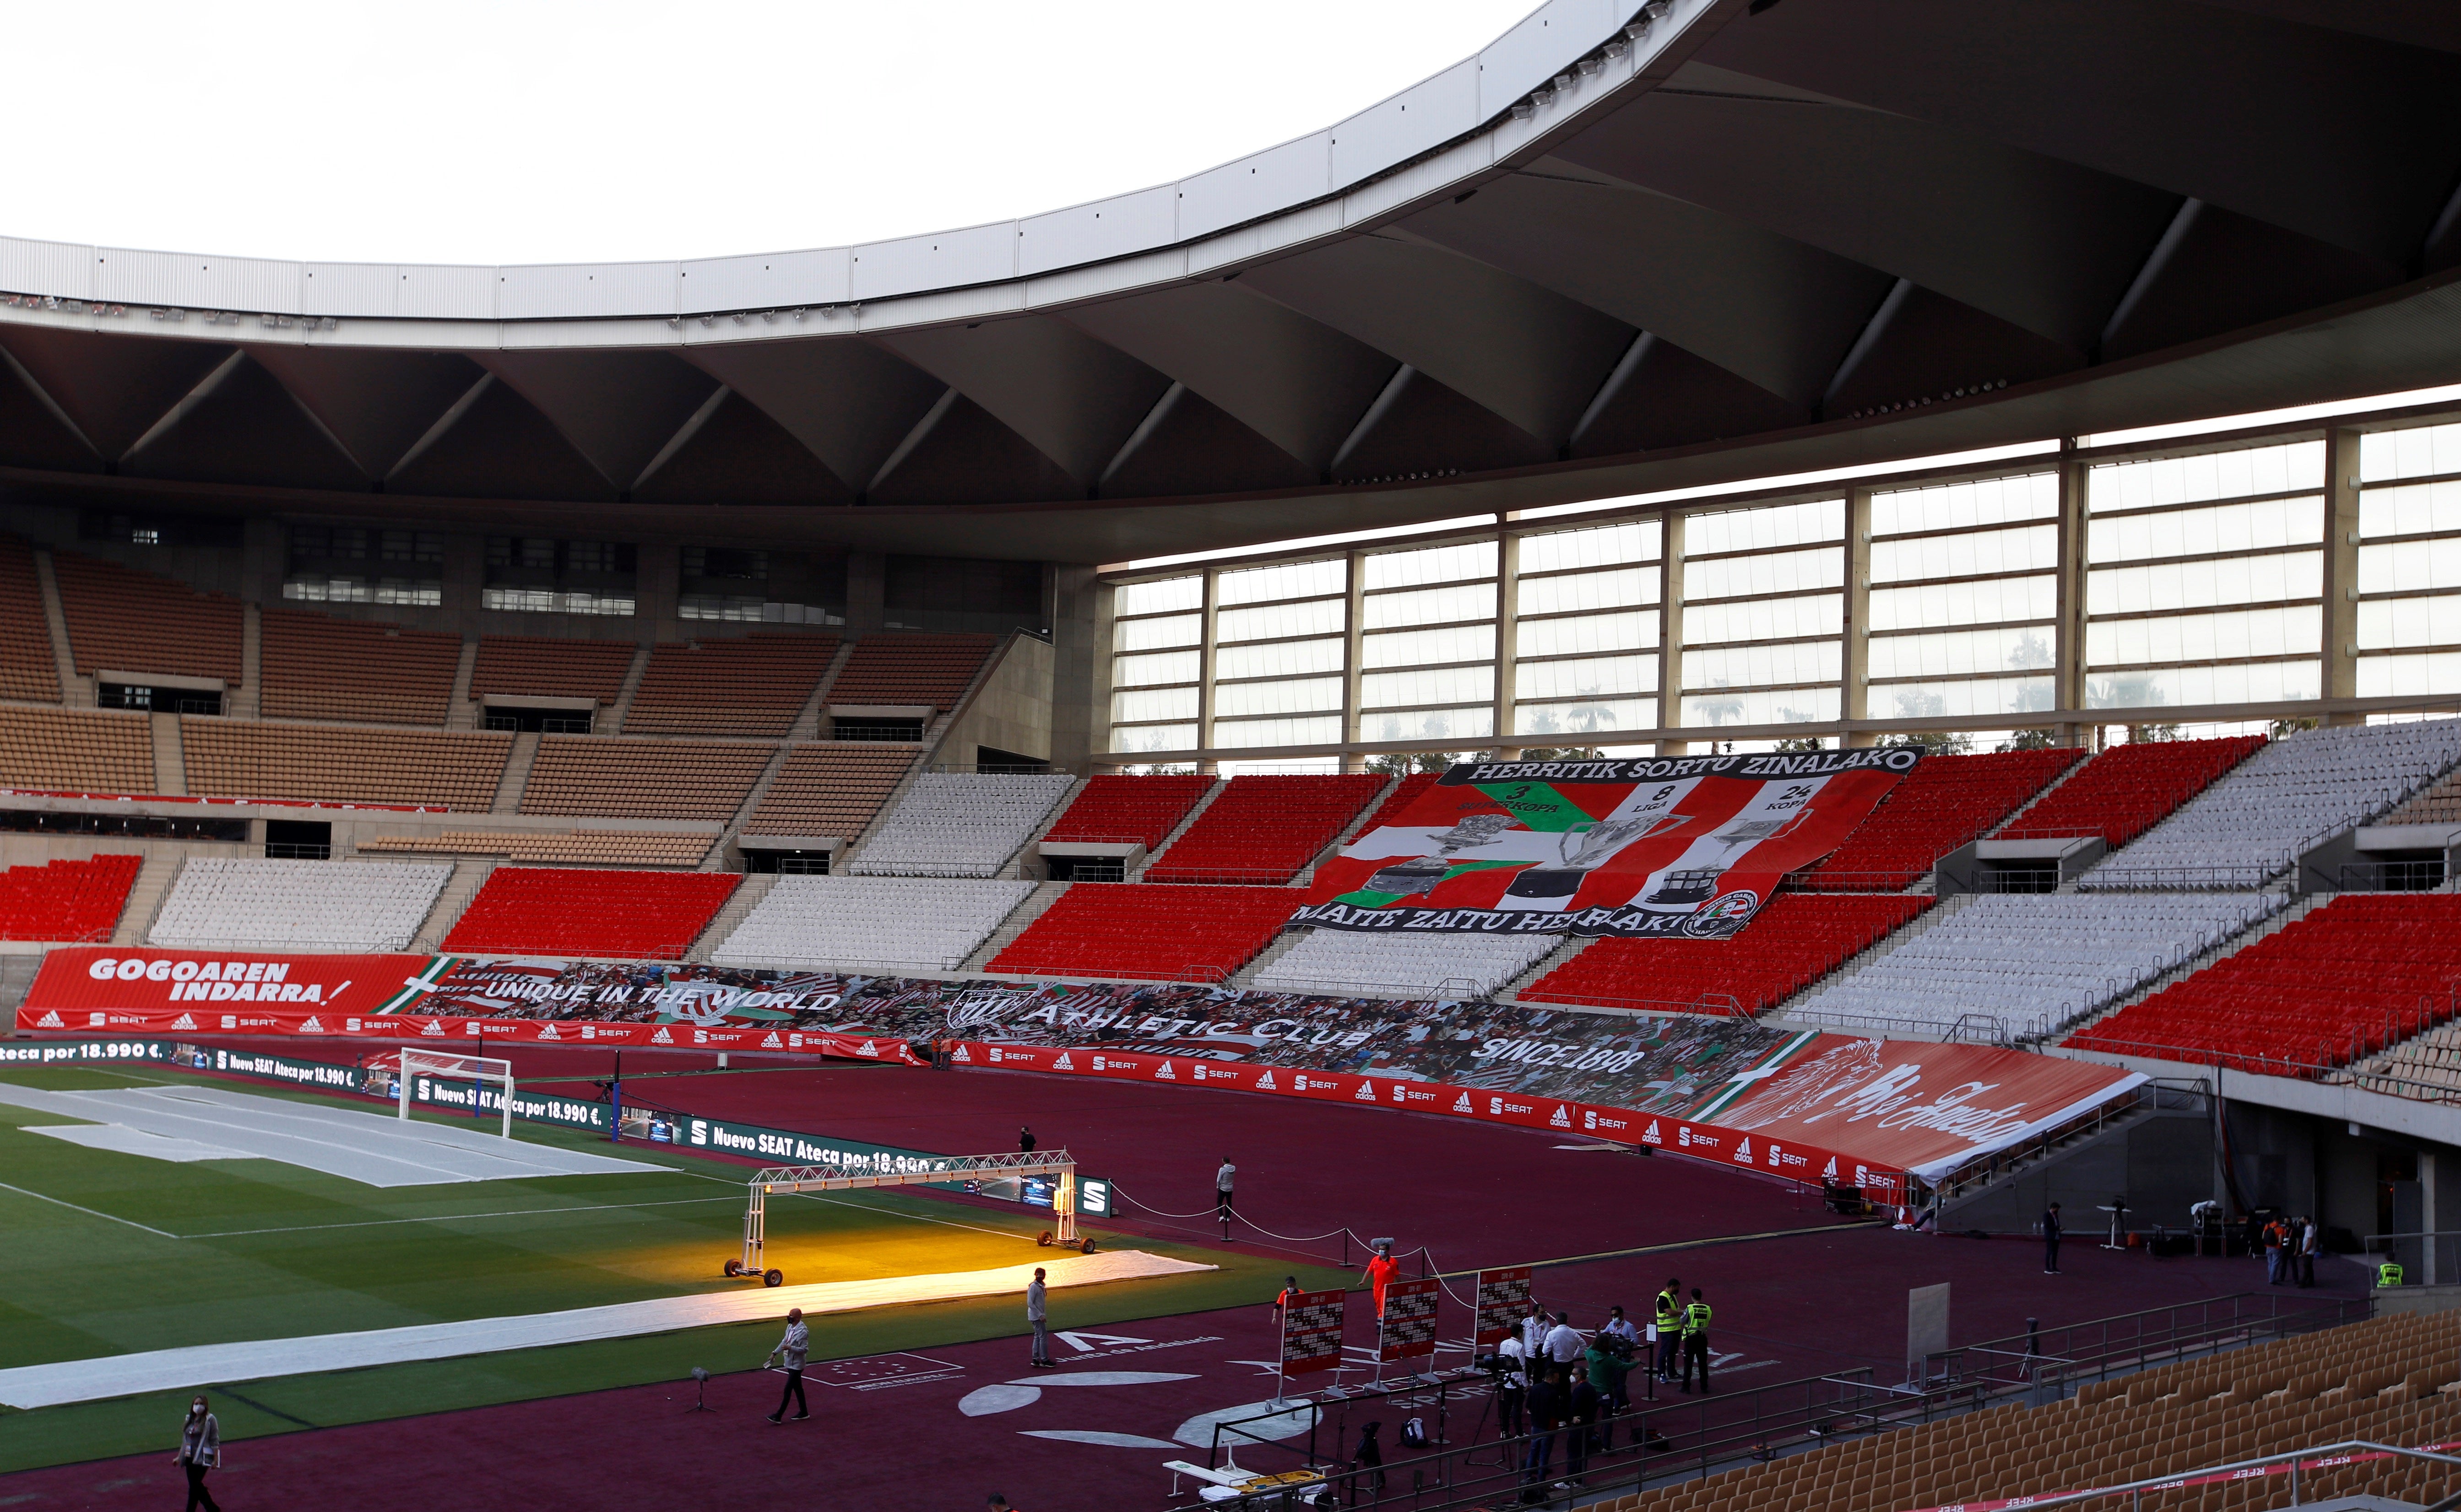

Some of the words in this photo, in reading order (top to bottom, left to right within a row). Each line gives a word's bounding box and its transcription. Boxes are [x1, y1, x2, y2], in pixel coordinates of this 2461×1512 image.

[1468, 762, 1626, 779] HERRITIK
[1627, 756, 1741, 778] SORTU
[1741, 749, 1917, 775] ZINALAKO
[1506, 785, 1531, 799] 3
[1652, 785, 1676, 801] 8
[1778, 785, 1811, 800] 24
[1457, 801, 1559, 813] SUPERKOPA
[1632, 801, 1667, 813] LIGA
[1765, 799, 1807, 810] KOPA
[1289, 904, 1405, 927] MAITE
[1402, 910, 1513, 930] ZAITU
[89, 958, 290, 983] GOGOAREN
[169, 980, 352, 1006] INDARRA!
[485, 981, 591, 1003] UNIQUE
[596, 986, 633, 1002] IN
[638, 988, 708, 1005] THE
[711, 989, 840, 1010] WORLD
[1019, 1005, 1238, 1036] ATHLETIC
[1252, 1019, 1373, 1047] CLUB
[806, 1038, 837, 1046] SEAT
[0, 1047, 39, 1060] teca
[43, 1047, 76, 1062] por
[80, 1043, 145, 1058] 18.990
[1005, 1053, 1035, 1061] SEAT
[1470, 1038, 1580, 1066] SINCE
[1561, 1048, 1645, 1074] 1898
[230, 1054, 254, 1071] Nuevo
[255, 1058, 274, 1074] SEAT
[275, 1061, 298, 1078] Ateca
[299, 1068, 314, 1082] por
[315, 1067, 344, 1085] 18.990
[1108, 1061, 1138, 1069] SEAT
[1155, 1071, 1176, 1080] adidas
[1209, 1070, 1238, 1079] SEAT
[1256, 1082, 1276, 1090] adidas
[1309, 1080, 1338, 1090] SEAT
[1355, 1092, 1376, 1101] adidas
[1408, 1091, 1436, 1101] SEAT
[434, 1084, 465, 1104] Nuevo
[526, 1102, 545, 1118] por
[548, 1101, 587, 1123] 18.990
[1453, 1104, 1473, 1113] adidas
[1504, 1103, 1533, 1114] SEAT
[1550, 1118, 1571, 1128] adidas
[1599, 1118, 1627, 1129] SEAT
[1642, 1134, 1662, 1145] adidas
[1692, 1134, 1719, 1147] SEAT
[714, 1127, 755, 1150] Nuevo
[758, 1134, 793, 1156] SEAT
[796, 1140, 840, 1164] Ateca
[843, 1152, 869, 1170] por
[1734, 1152, 1753, 1164] adidas
[1782, 1153, 1808, 1167] SEAT
[1869, 1174, 1896, 1188] SEAT
[1055, 1352, 1111, 1363] Junta
[2232, 1467, 2265, 1479] RFEF
